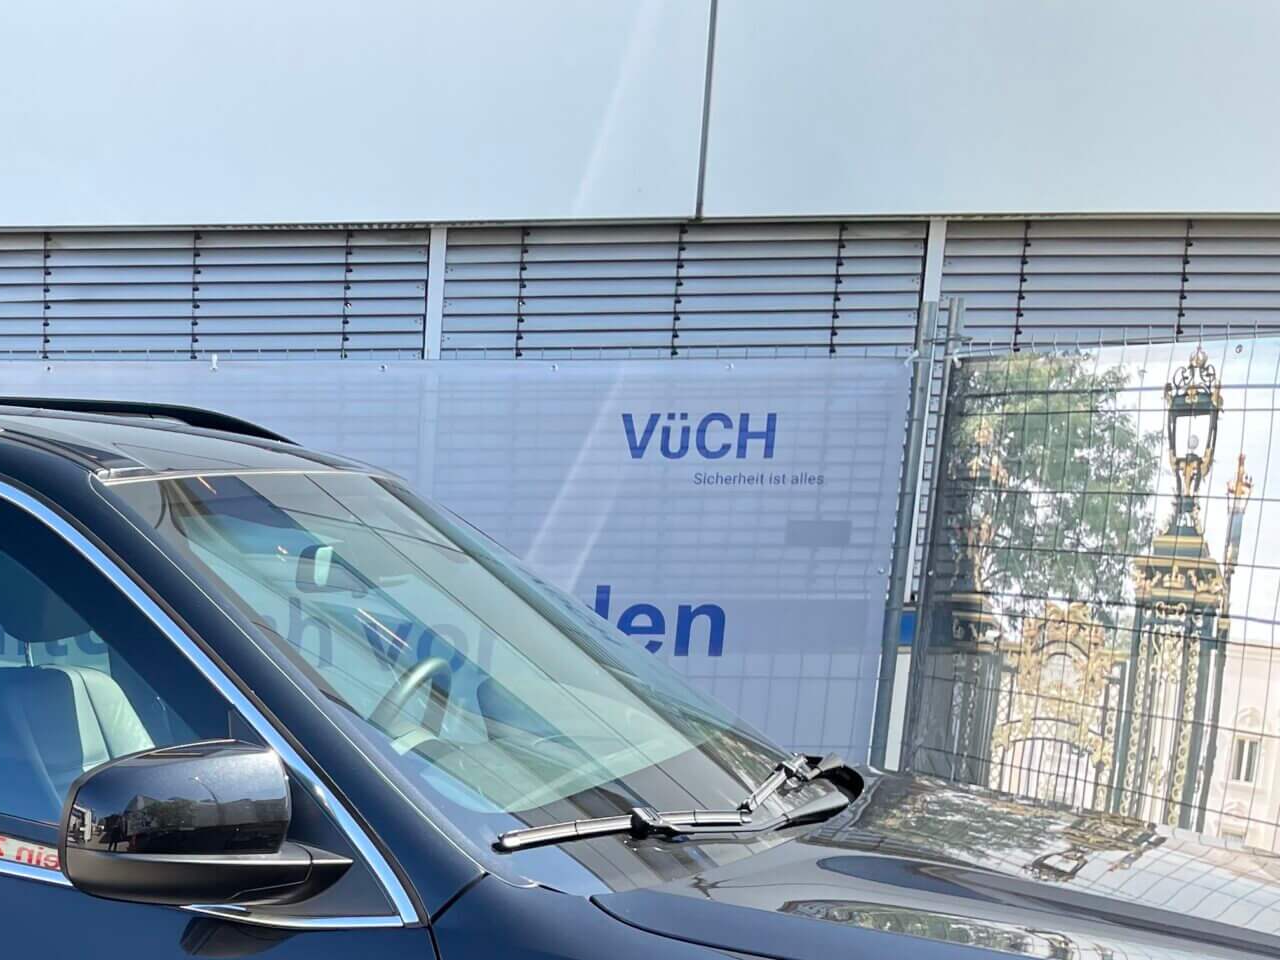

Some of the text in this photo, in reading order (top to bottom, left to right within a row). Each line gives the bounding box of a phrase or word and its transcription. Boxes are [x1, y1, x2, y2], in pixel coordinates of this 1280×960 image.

[621, 412, 778, 460] VüCH
[693, 472, 825, 486] Sicherheit ist alles
